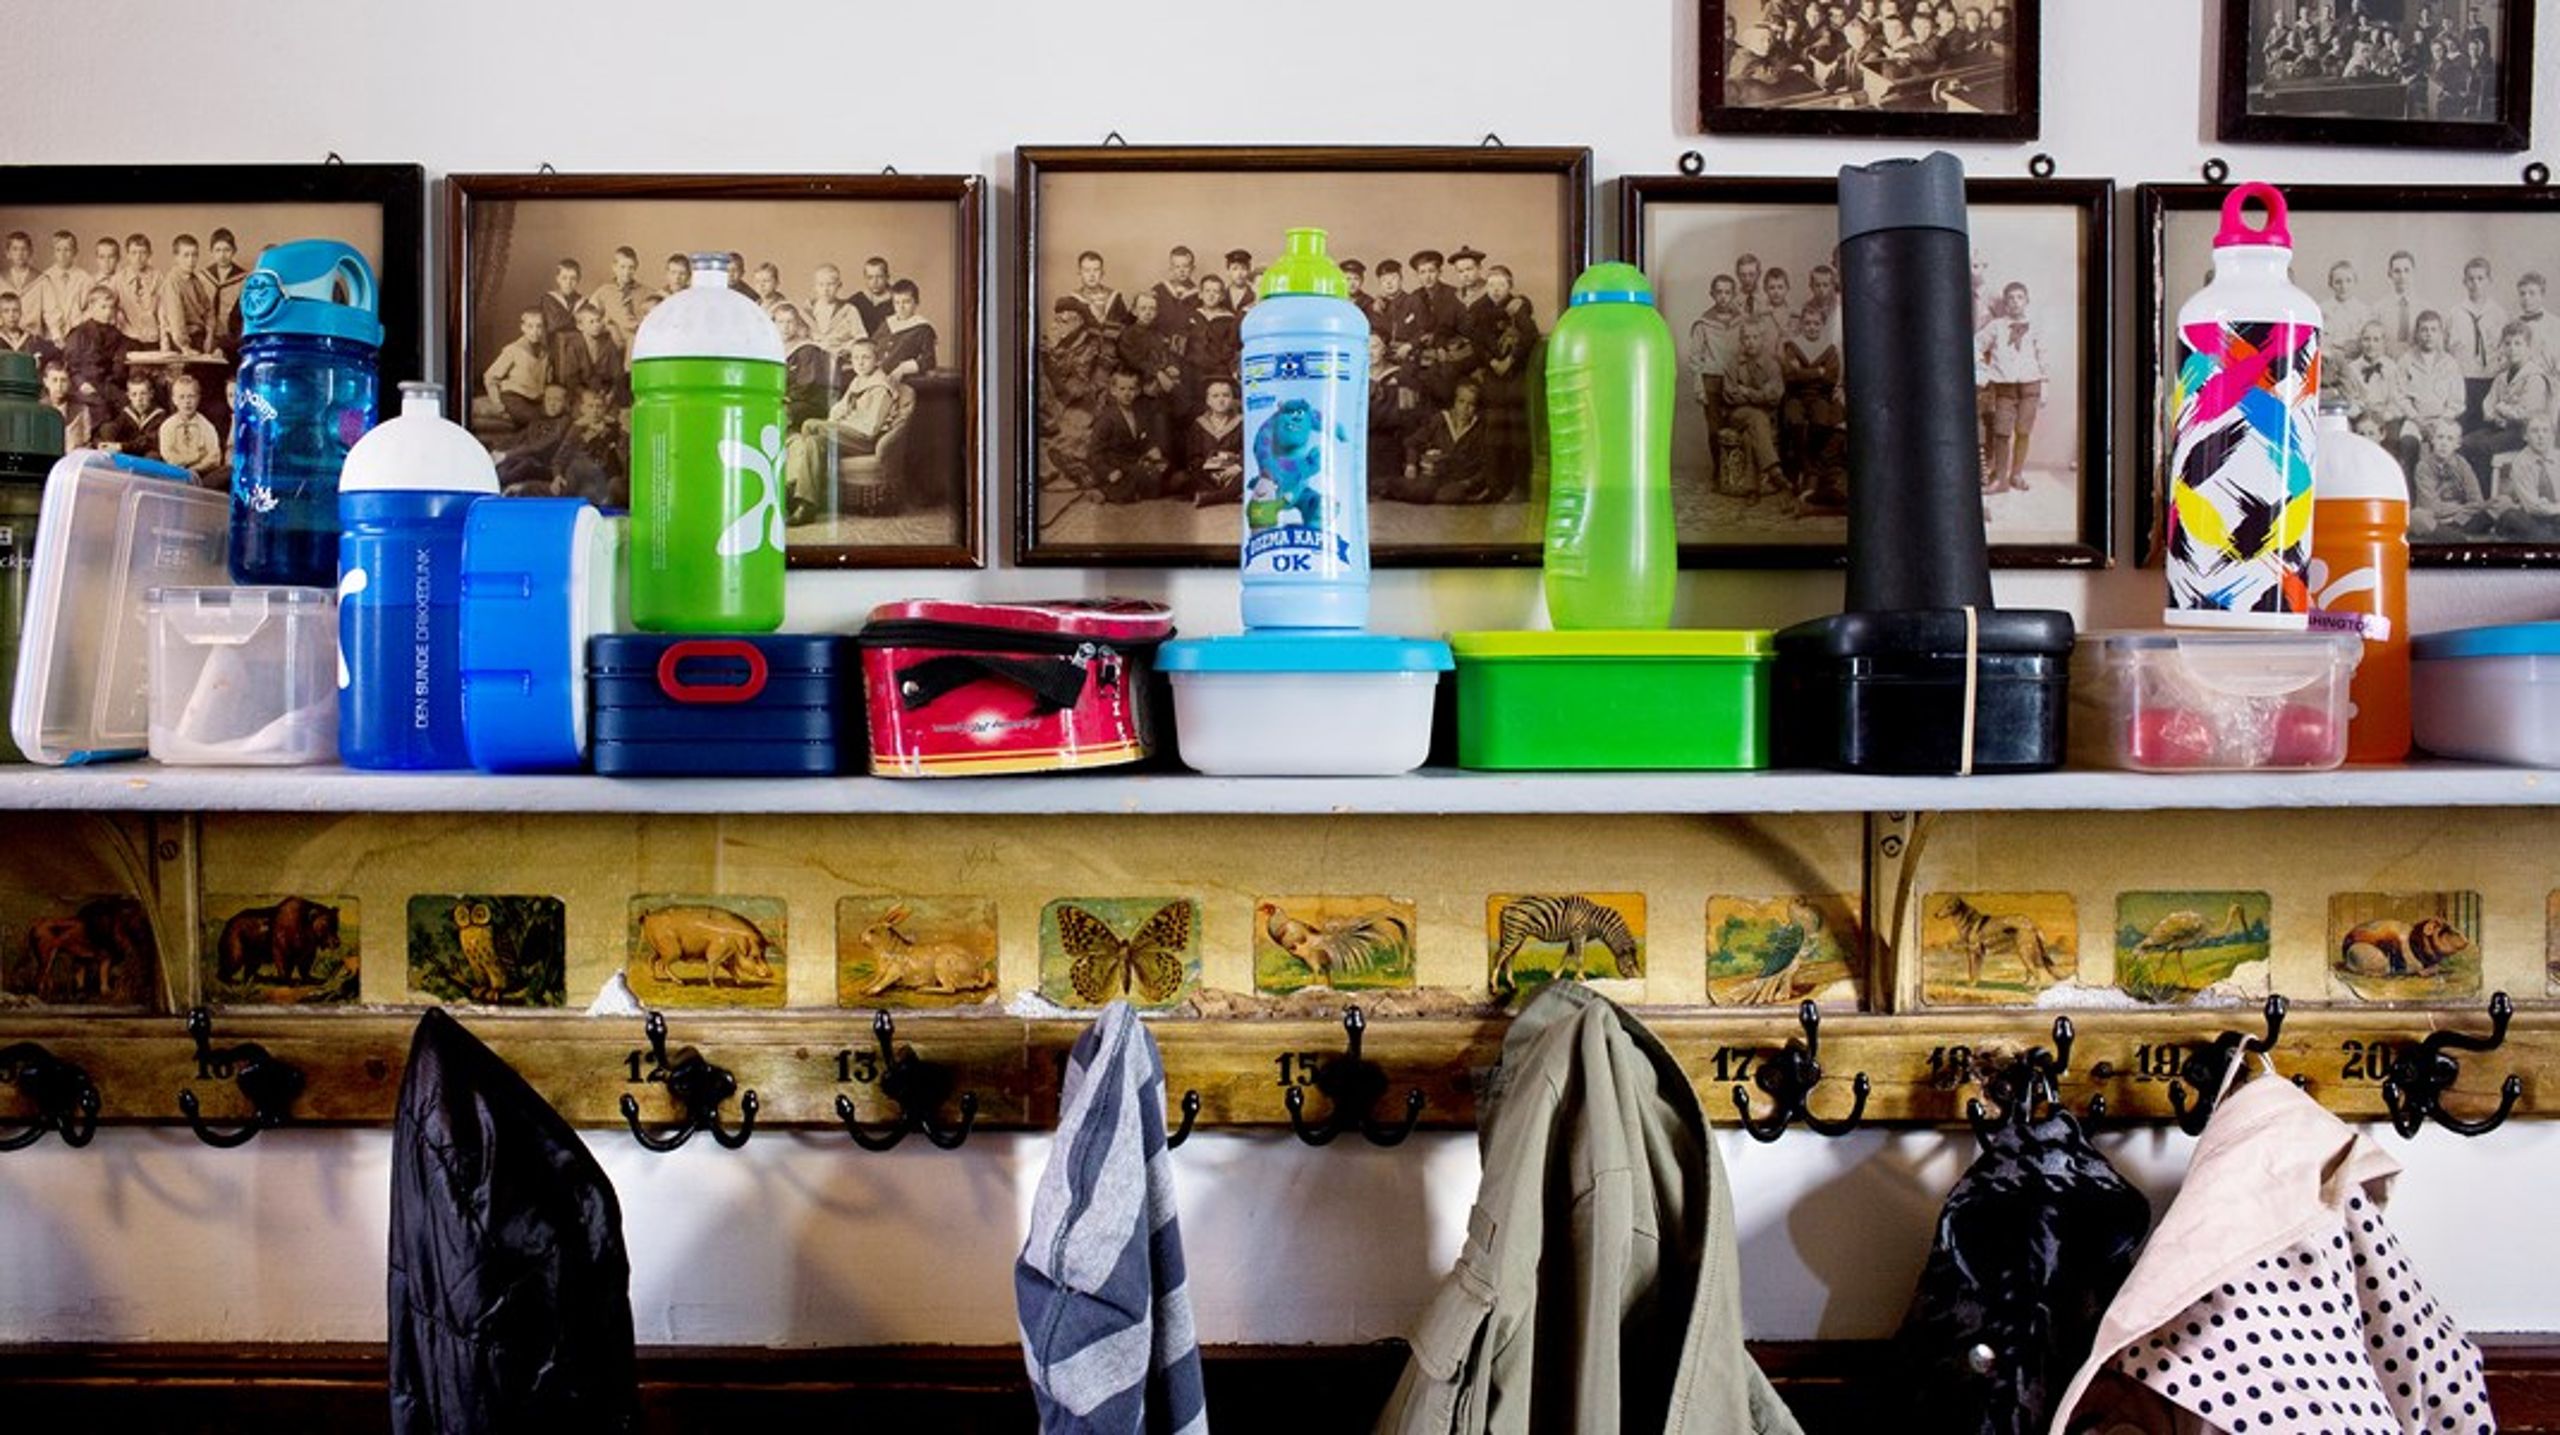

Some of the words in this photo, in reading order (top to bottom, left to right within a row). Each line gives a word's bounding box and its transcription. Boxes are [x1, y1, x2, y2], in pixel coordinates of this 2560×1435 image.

[415, 643, 430, 695] SUNDE
[415, 698, 430, 728] DEN
[623, 1049, 669, 1084] 12
[834, 1049, 879, 1084] 13
[1274, 1051, 1319, 1087] 15
[1710, 1046, 1757, 1082] 17
[2134, 1043, 2181, 1082] 19
[2341, 1040, 2391, 1081] 20
